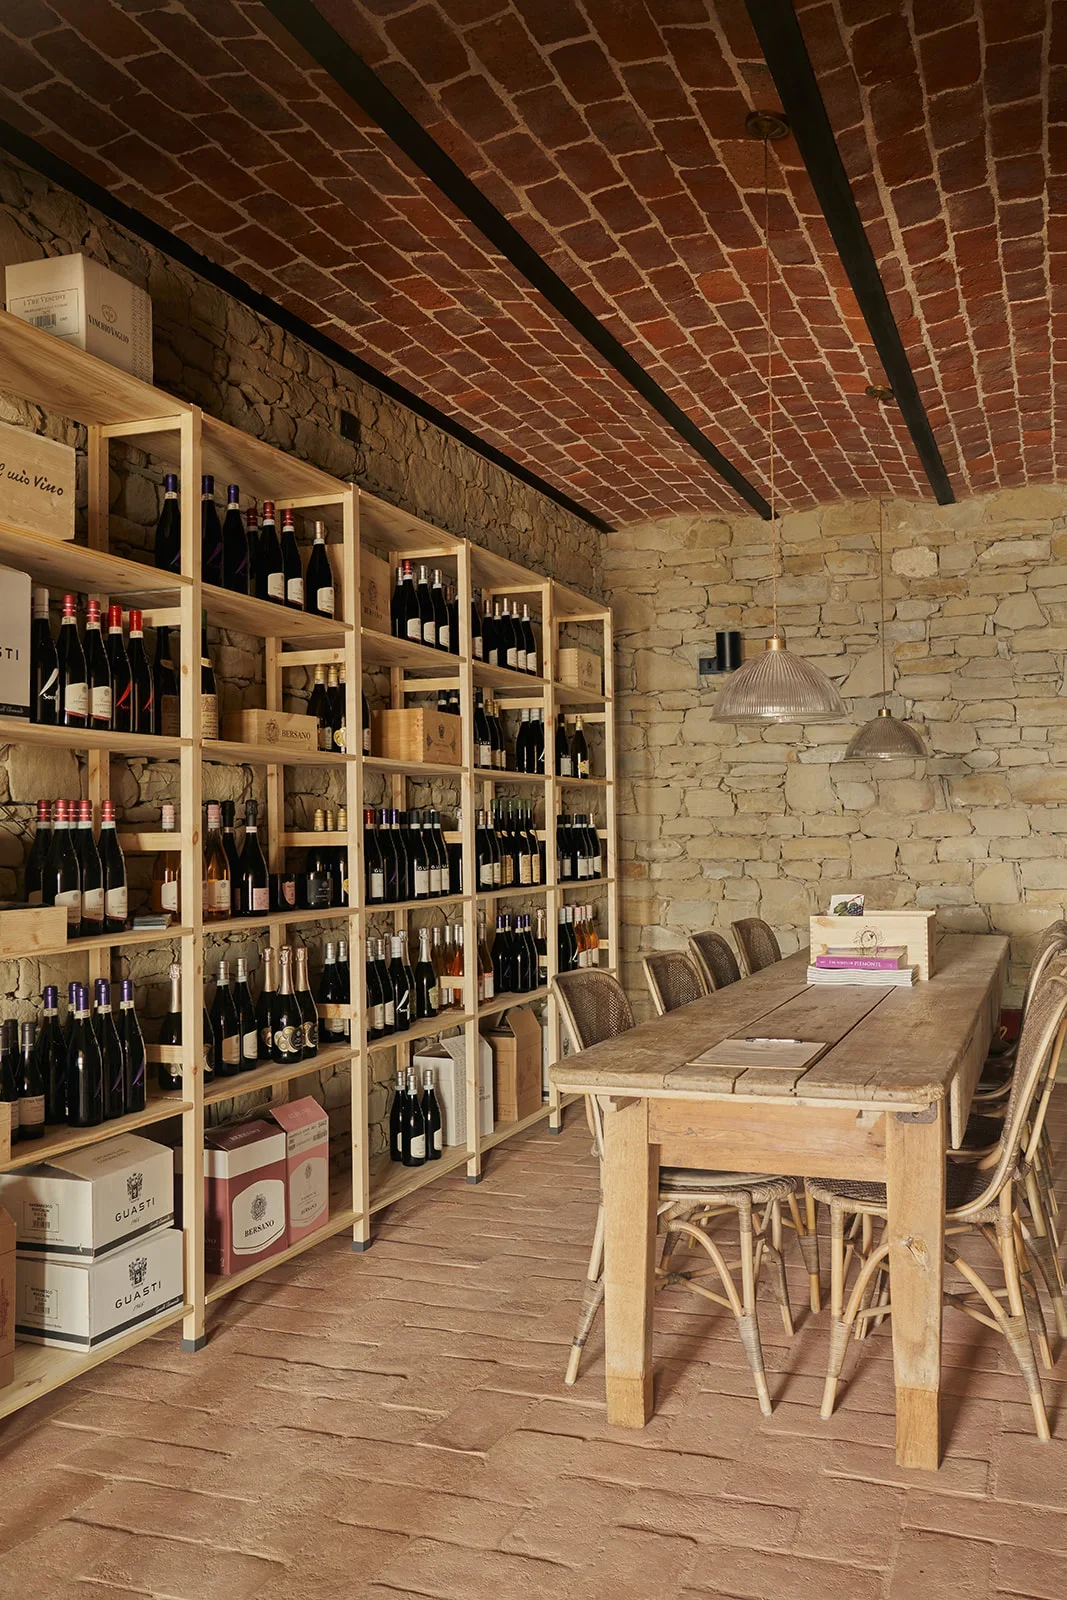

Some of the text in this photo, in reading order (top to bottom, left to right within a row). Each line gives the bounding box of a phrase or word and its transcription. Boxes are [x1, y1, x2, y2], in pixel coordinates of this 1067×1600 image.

[34, 475, 64, 496] Vino
[281, 729, 311, 740] BERSANO
[115, 1197, 155, 1222] GUASTI
[244, 1219, 275, 1238] BERSANO
[115, 1280, 162, 1309] GUASTI
